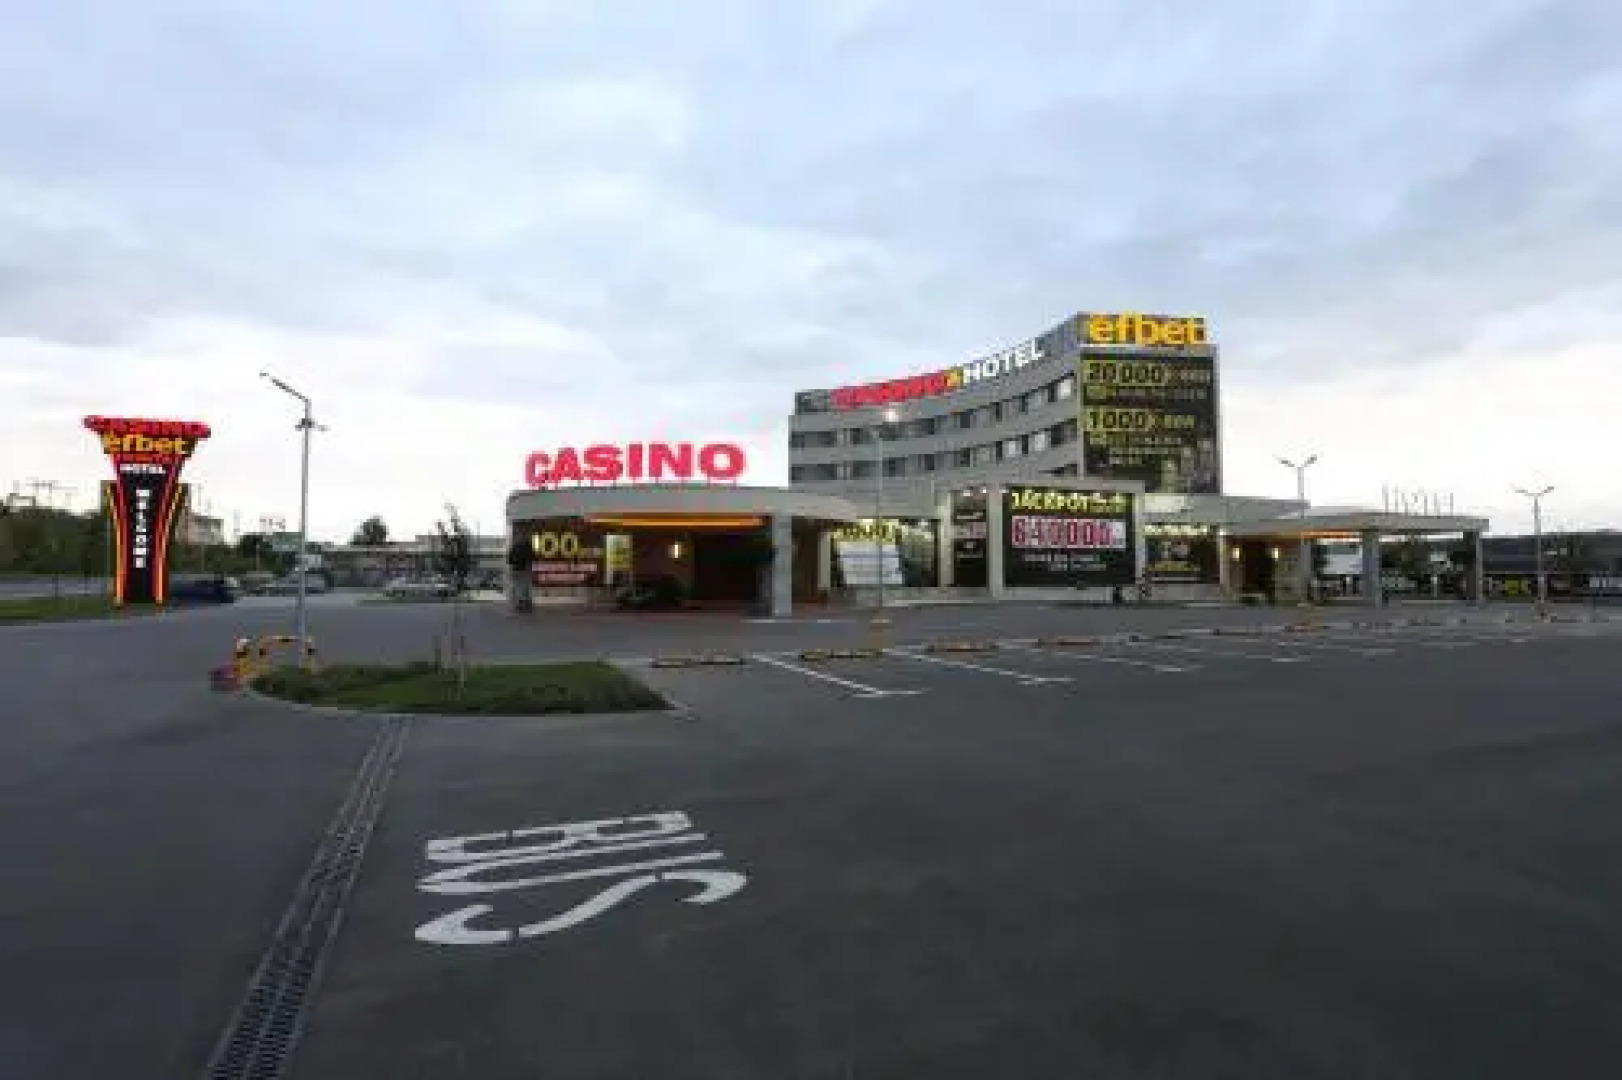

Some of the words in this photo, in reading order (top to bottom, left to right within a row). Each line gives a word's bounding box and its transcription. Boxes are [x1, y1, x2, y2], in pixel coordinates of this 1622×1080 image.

[1088, 313, 1207, 344] efbet
[962, 339, 1044, 383] HOTEL
[103, 432, 189, 454] efbet
[524, 442, 746, 486] CASINO
[414, 811, 748, 946] BUS
